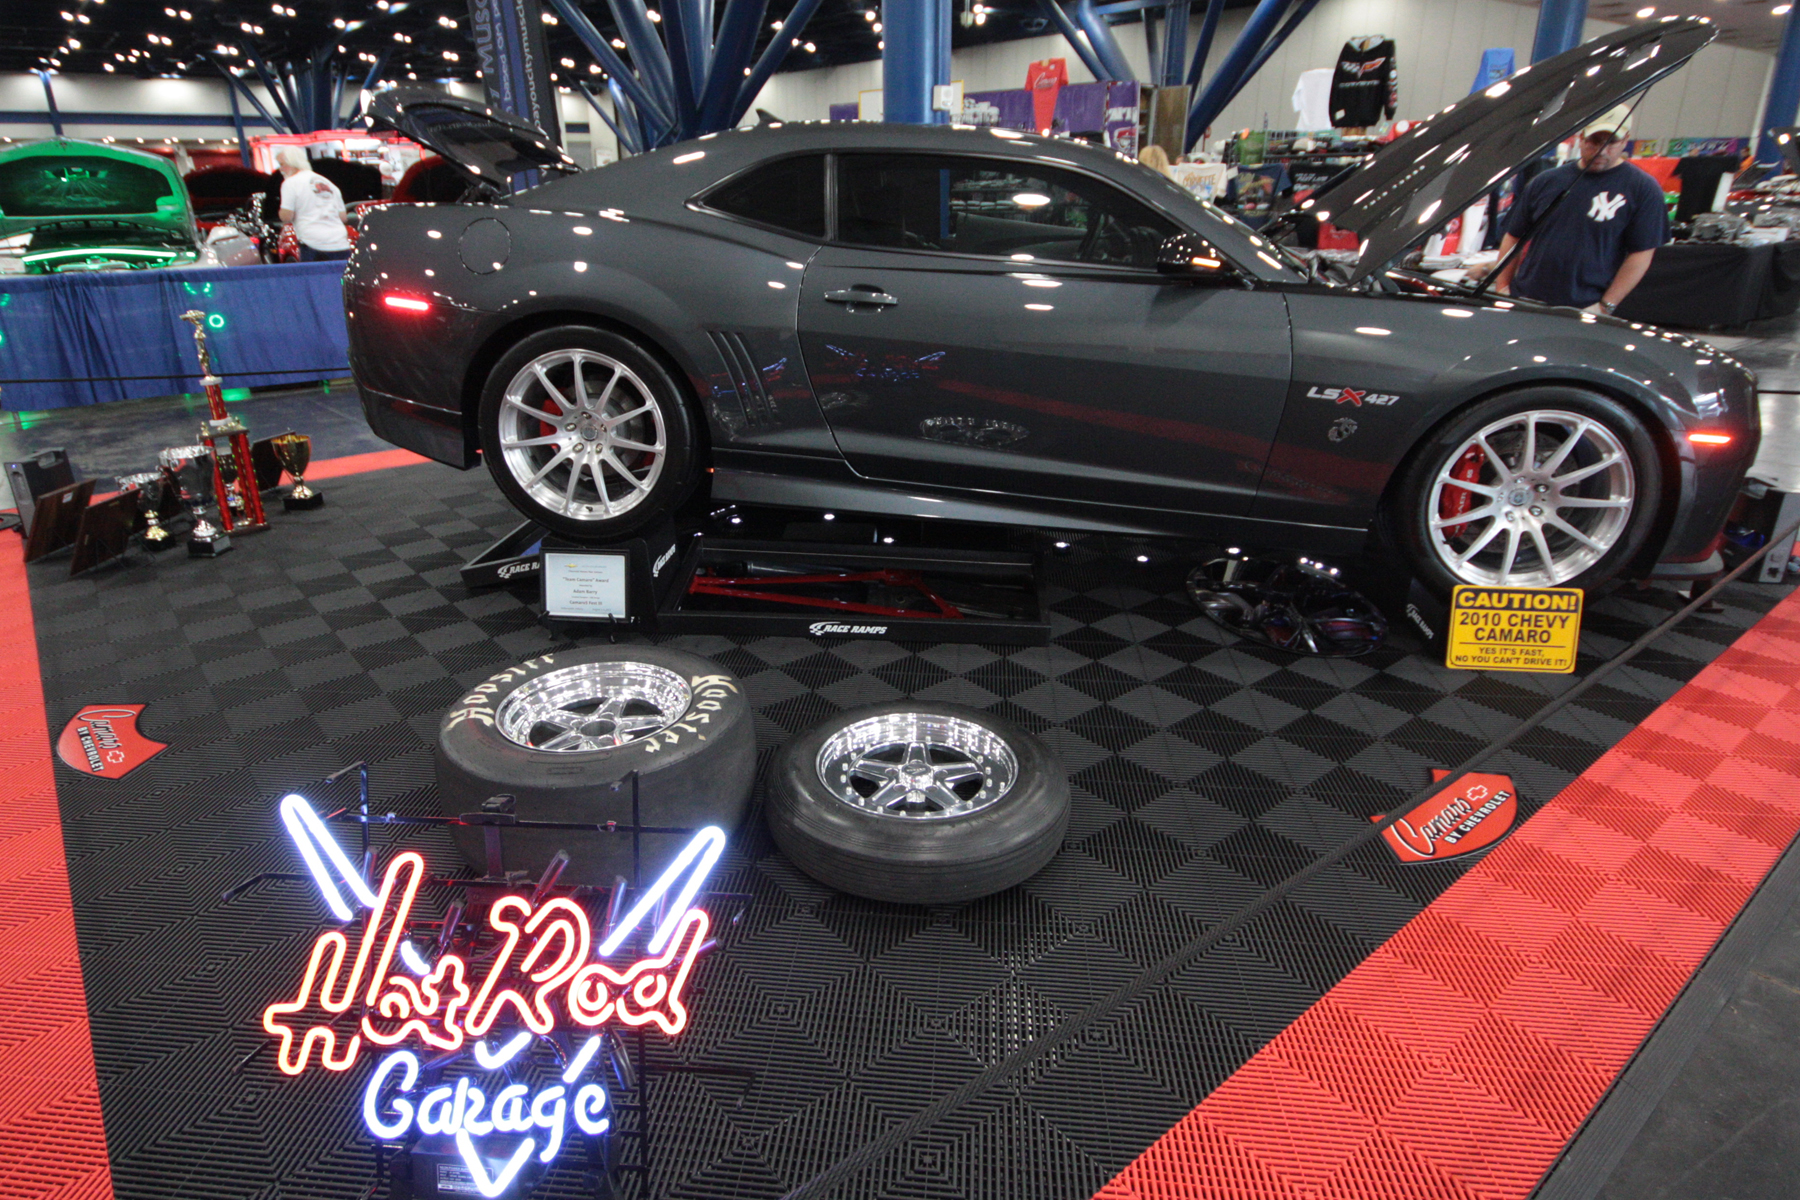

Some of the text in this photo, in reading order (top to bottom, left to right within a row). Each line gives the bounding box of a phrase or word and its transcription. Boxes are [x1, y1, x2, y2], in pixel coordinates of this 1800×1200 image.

[1586, 191, 1627, 222] NY
[1306, 386, 1400, 407] LSX 427
[509, 563, 531, 574] RACE
[1458, 591, 1578, 610] CAUTION!
[822, 625, 888, 634] RACE RAMPS
[1459, 612, 1570, 629] 2010 CHEVY
[1474, 627, 1552, 643] CAMARO
[1455, 655, 1567, 667] NO YOU CAN'T DRIVE IT!
[1479, 647, 1545, 658] YES IT'S FAST,
[77, 709, 136, 749] Camaro
[77, 726, 105, 772] BY CHEVROLET
[1390, 797, 1474, 857] Camaro
[1443, 790, 1513, 845] BY CHEVROLET
[263, 851, 710, 1075] Hot Rod
[363, 1049, 610, 1163] Garage
